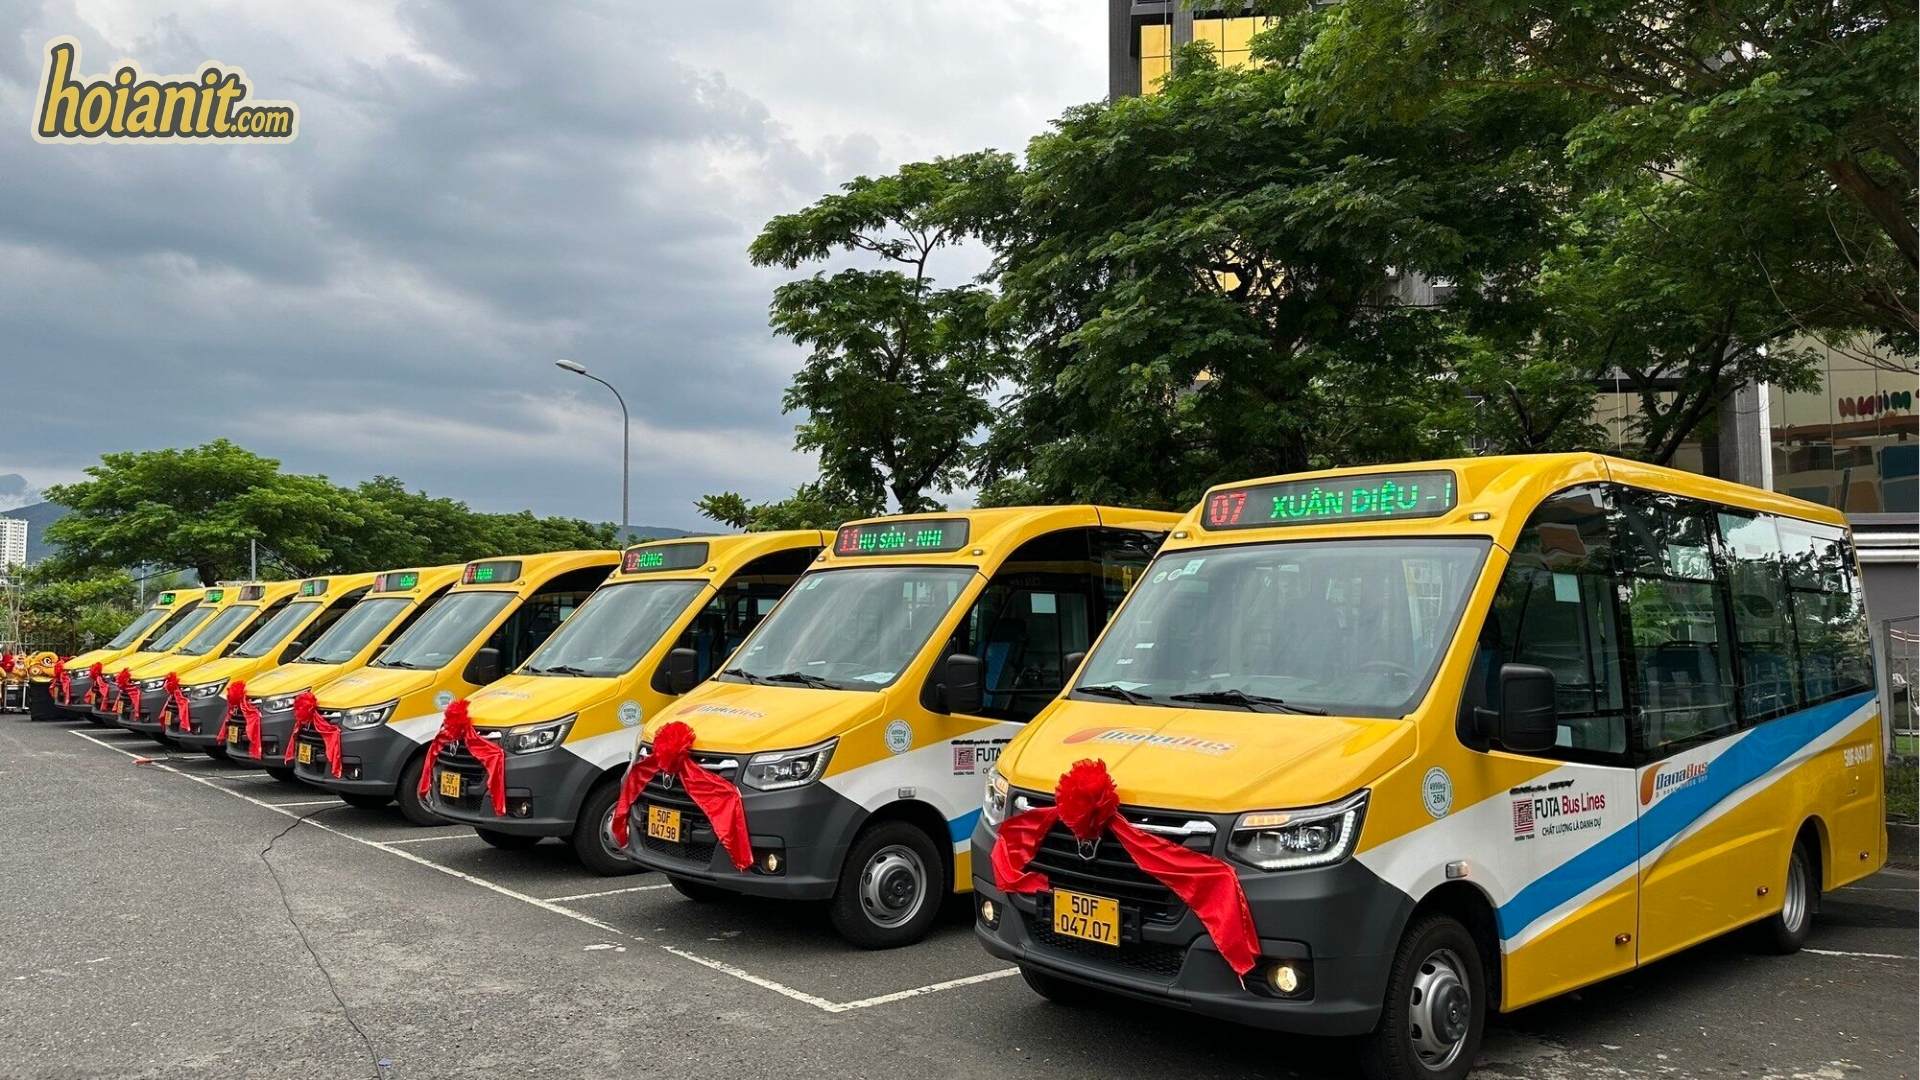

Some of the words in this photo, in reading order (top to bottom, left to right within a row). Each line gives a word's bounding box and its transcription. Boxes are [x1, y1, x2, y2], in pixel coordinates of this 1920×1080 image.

[1210, 492, 1248, 526] 07
[1270, 487, 1344, 519] XUÂN
[1351, 481, 1419, 515] DIỆU
[840, 528, 859, 552] 11
[916, 530, 942, 547] NHI
[1656, 761, 1709, 790] DanaBus
[1432, 794, 1446, 804] 26N
[1534, 797, 1561, 819] FUTA
[1562, 795, 1580, 815] Bus
[1581, 792, 1606, 812] Lines
[656, 810, 672, 824] 50F
[651, 823, 676, 840] 047.98
[1071, 896, 1099, 917] 50F
[1061, 914, 1111, 941] 047.07
